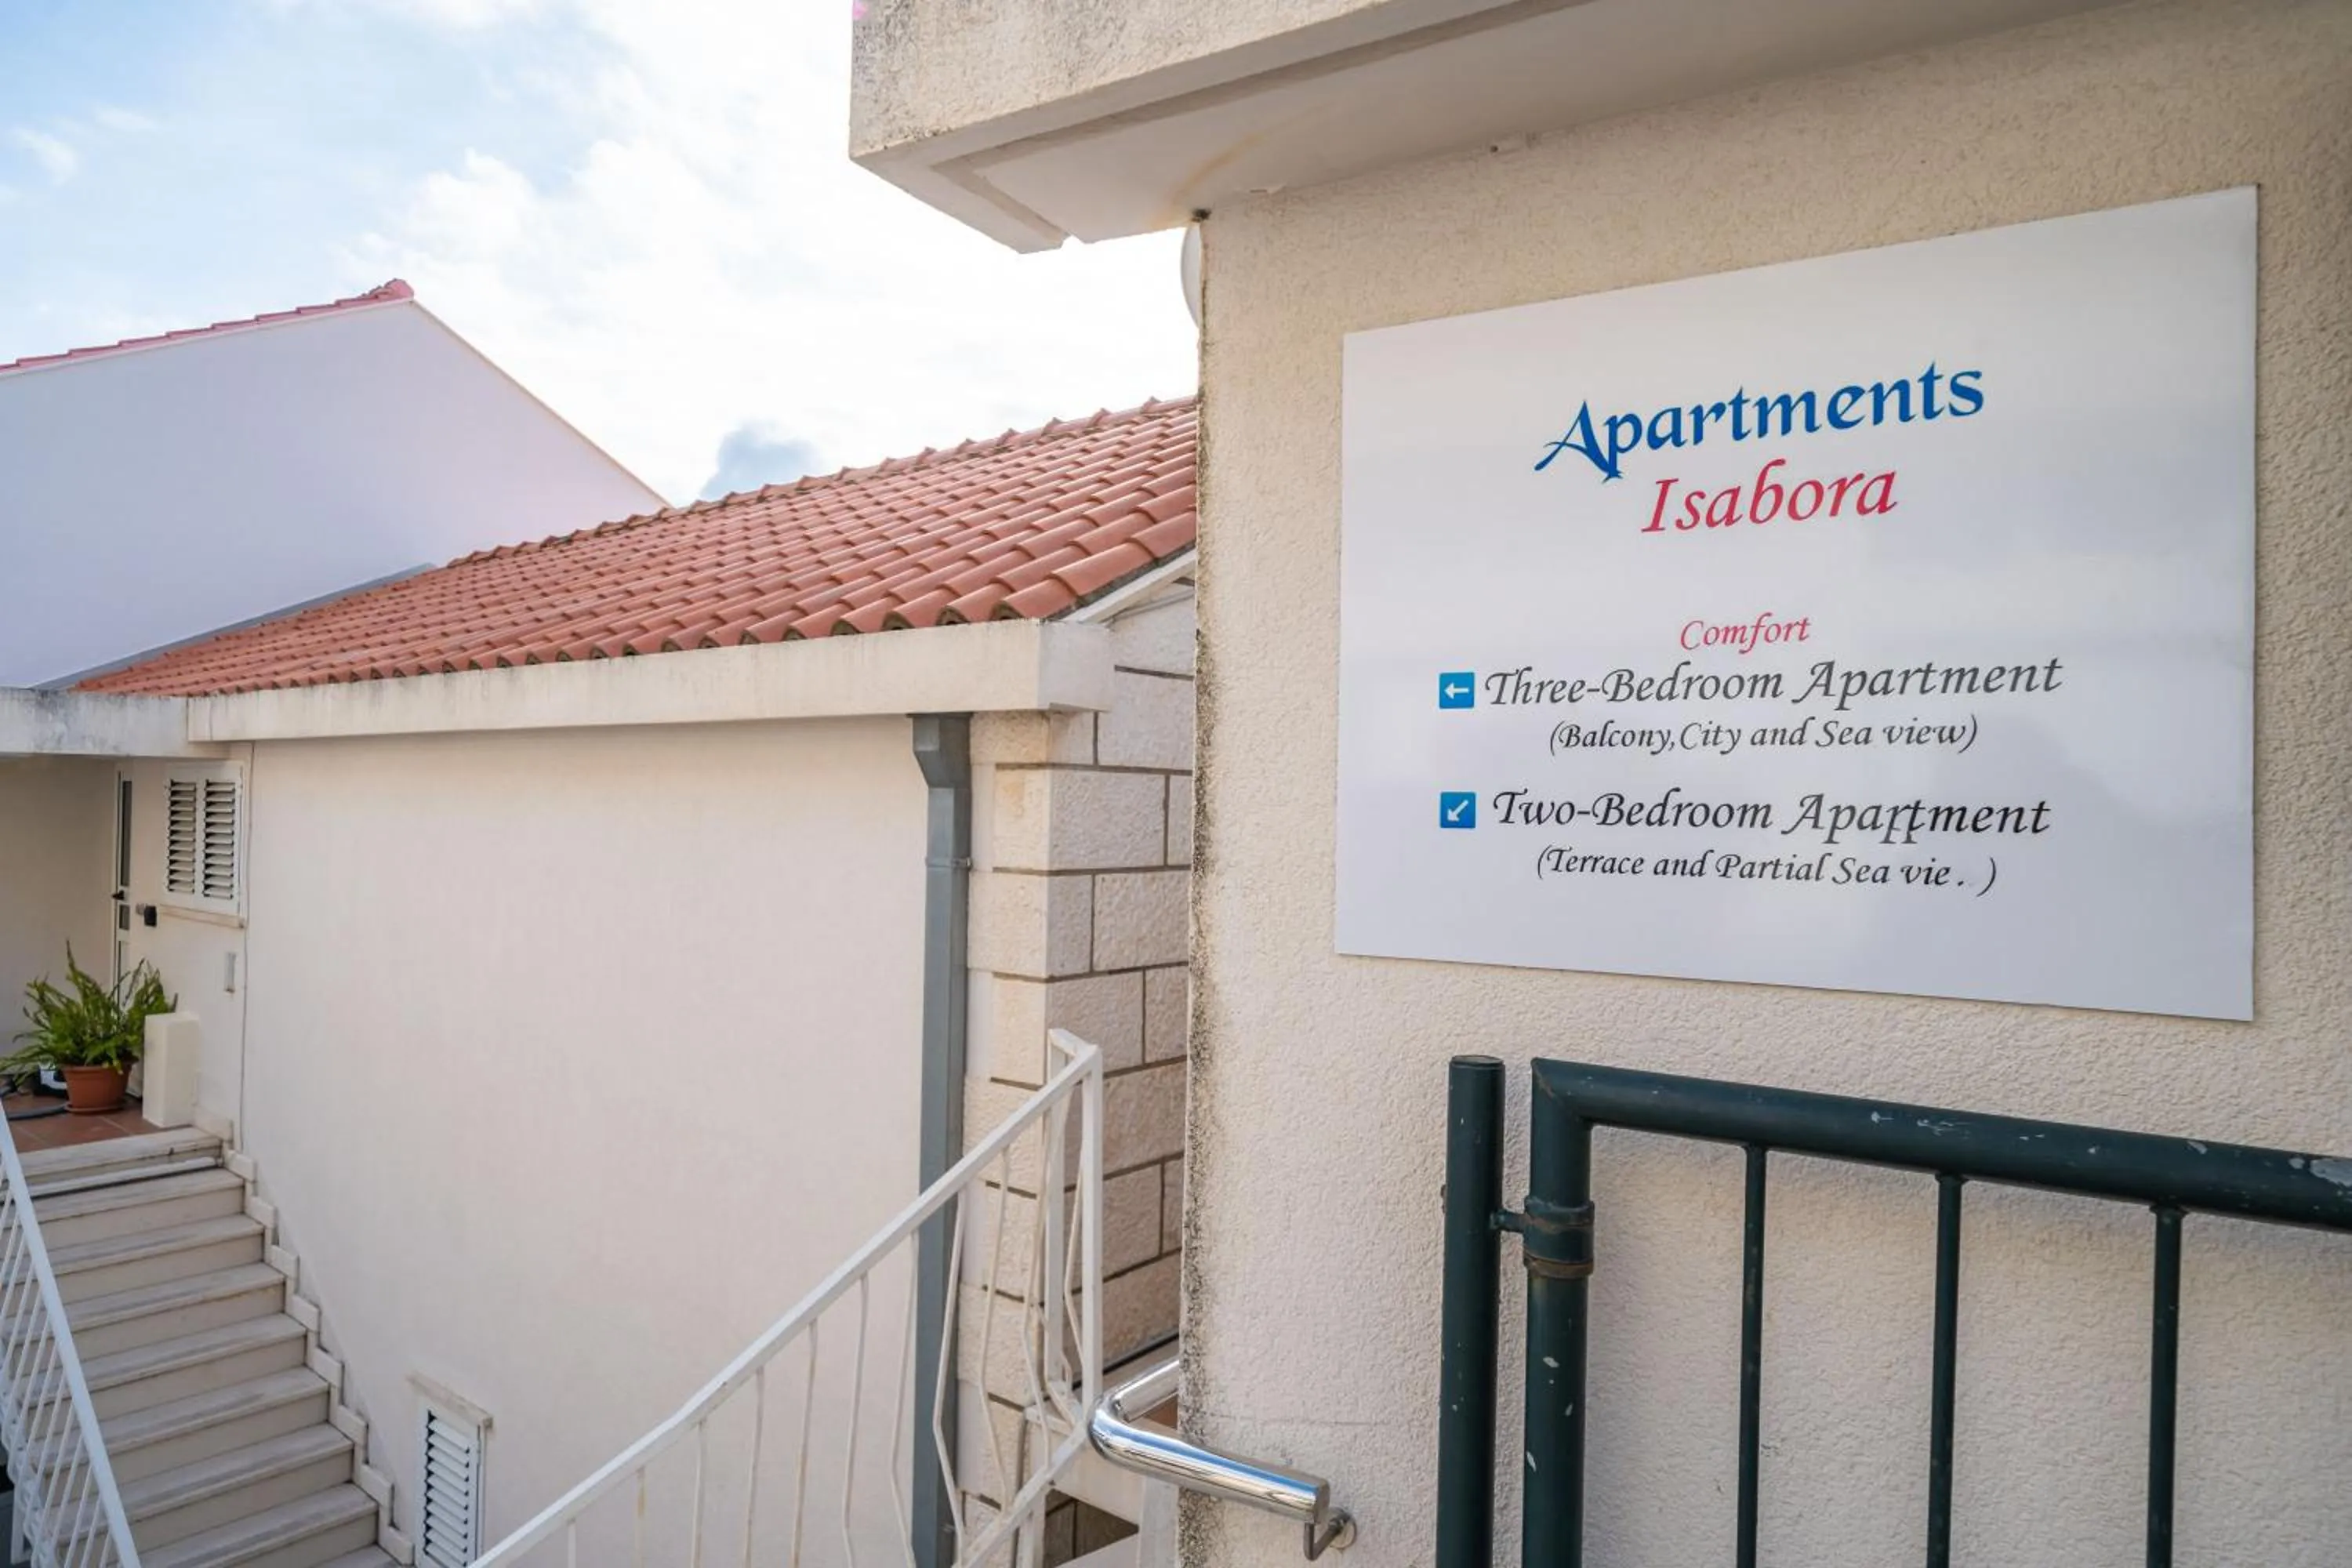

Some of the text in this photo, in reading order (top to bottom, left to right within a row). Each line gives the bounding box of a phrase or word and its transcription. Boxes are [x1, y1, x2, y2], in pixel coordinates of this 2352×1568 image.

[1533, 361, 1985, 485] Apartments
[1641, 458, 1898, 534] Isabora
[1680, 612, 1811, 655] Comfort
[1484, 657, 2064, 712] Three-Bedroom Apartment
[1750, 715, 1817, 748] and
[1814, 720, 1873, 748] Sea
[1882, 713, 1978, 754] view)
[1492, 786, 2053, 845] Two-Bedroom Apartment
[1536, 844, 1646, 880] (Terrace
[1652, 848, 1712, 877] and
[1714, 851, 1834, 883] Partial
[1831, 856, 1892, 885] Sea
